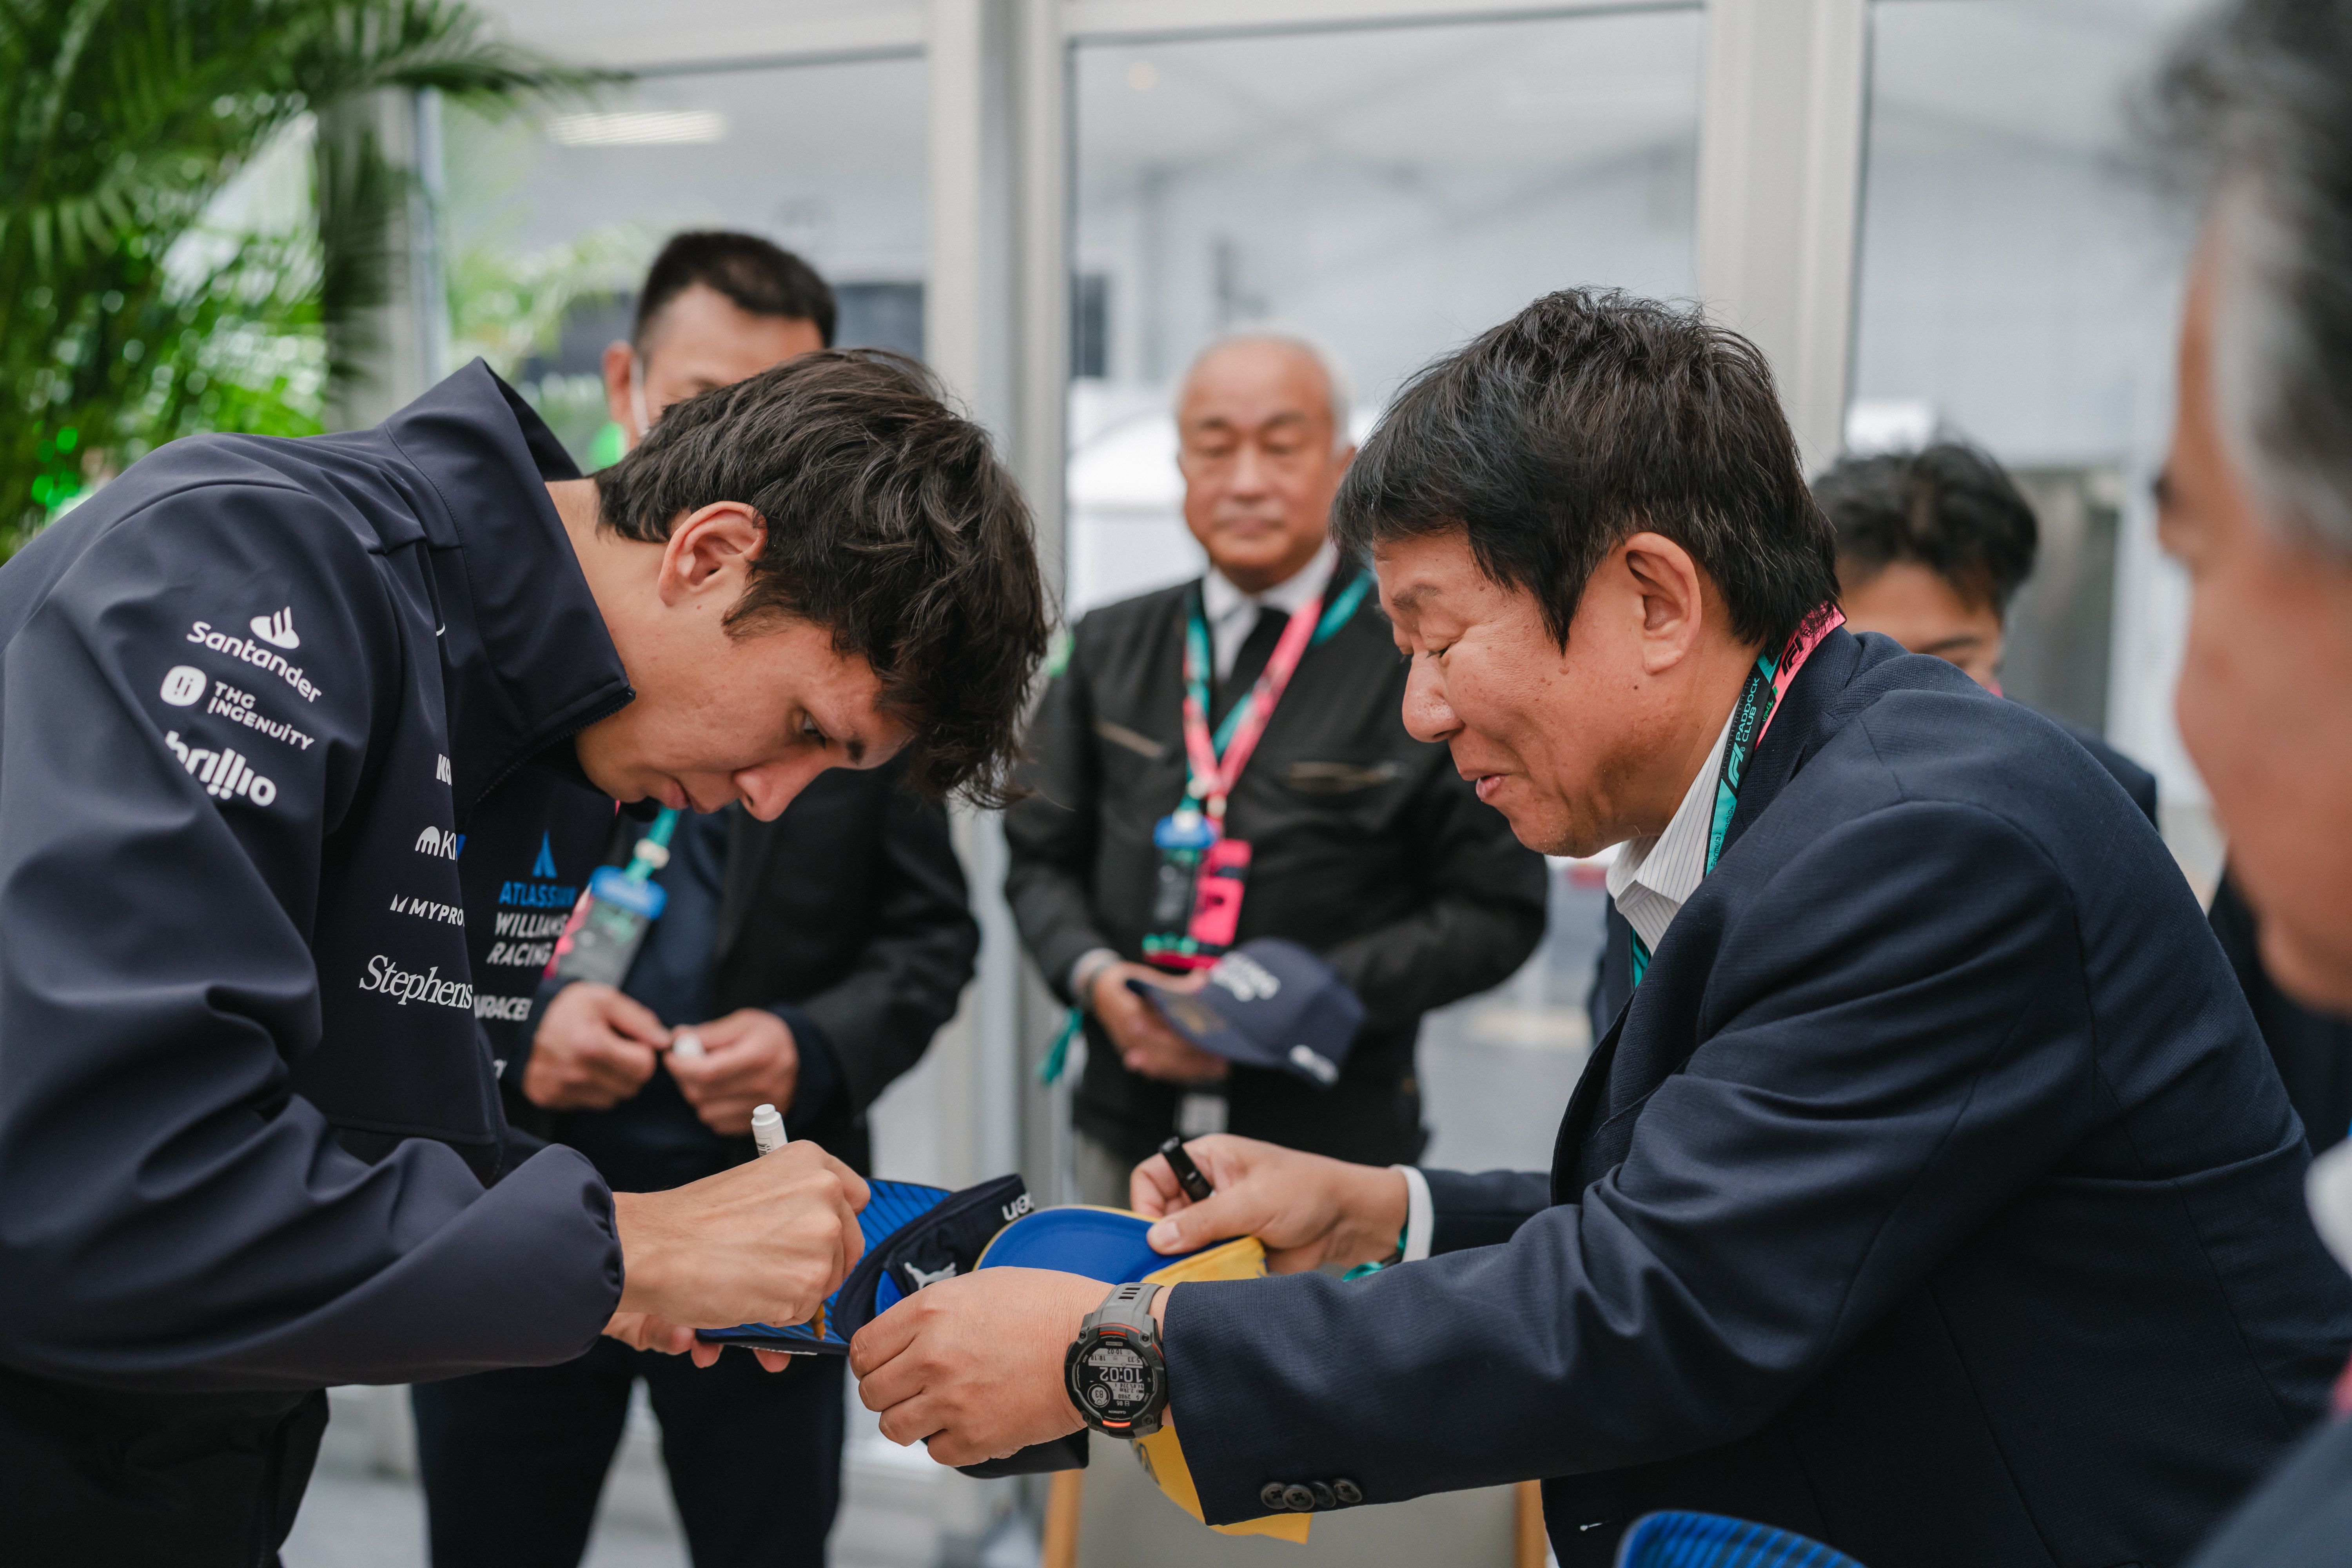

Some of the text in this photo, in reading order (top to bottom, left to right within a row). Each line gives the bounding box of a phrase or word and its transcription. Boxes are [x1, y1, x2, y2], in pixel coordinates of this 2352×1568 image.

[186, 621, 322, 703] Santander
[215, 681, 256, 710] THG
[1735, 677, 1760, 741] PADDOCK
[1742, 706, 1757, 742] CLUB
[1711, 836, 1721, 867] Formula
[499, 881, 577, 908] ATLASS
[408, 898, 465, 927] MYPRO
[359, 955, 473, 1009] Stephens
[1099, 1367, 1143, 1383] 10:02
[1095, 1390, 1103, 1398] 83
